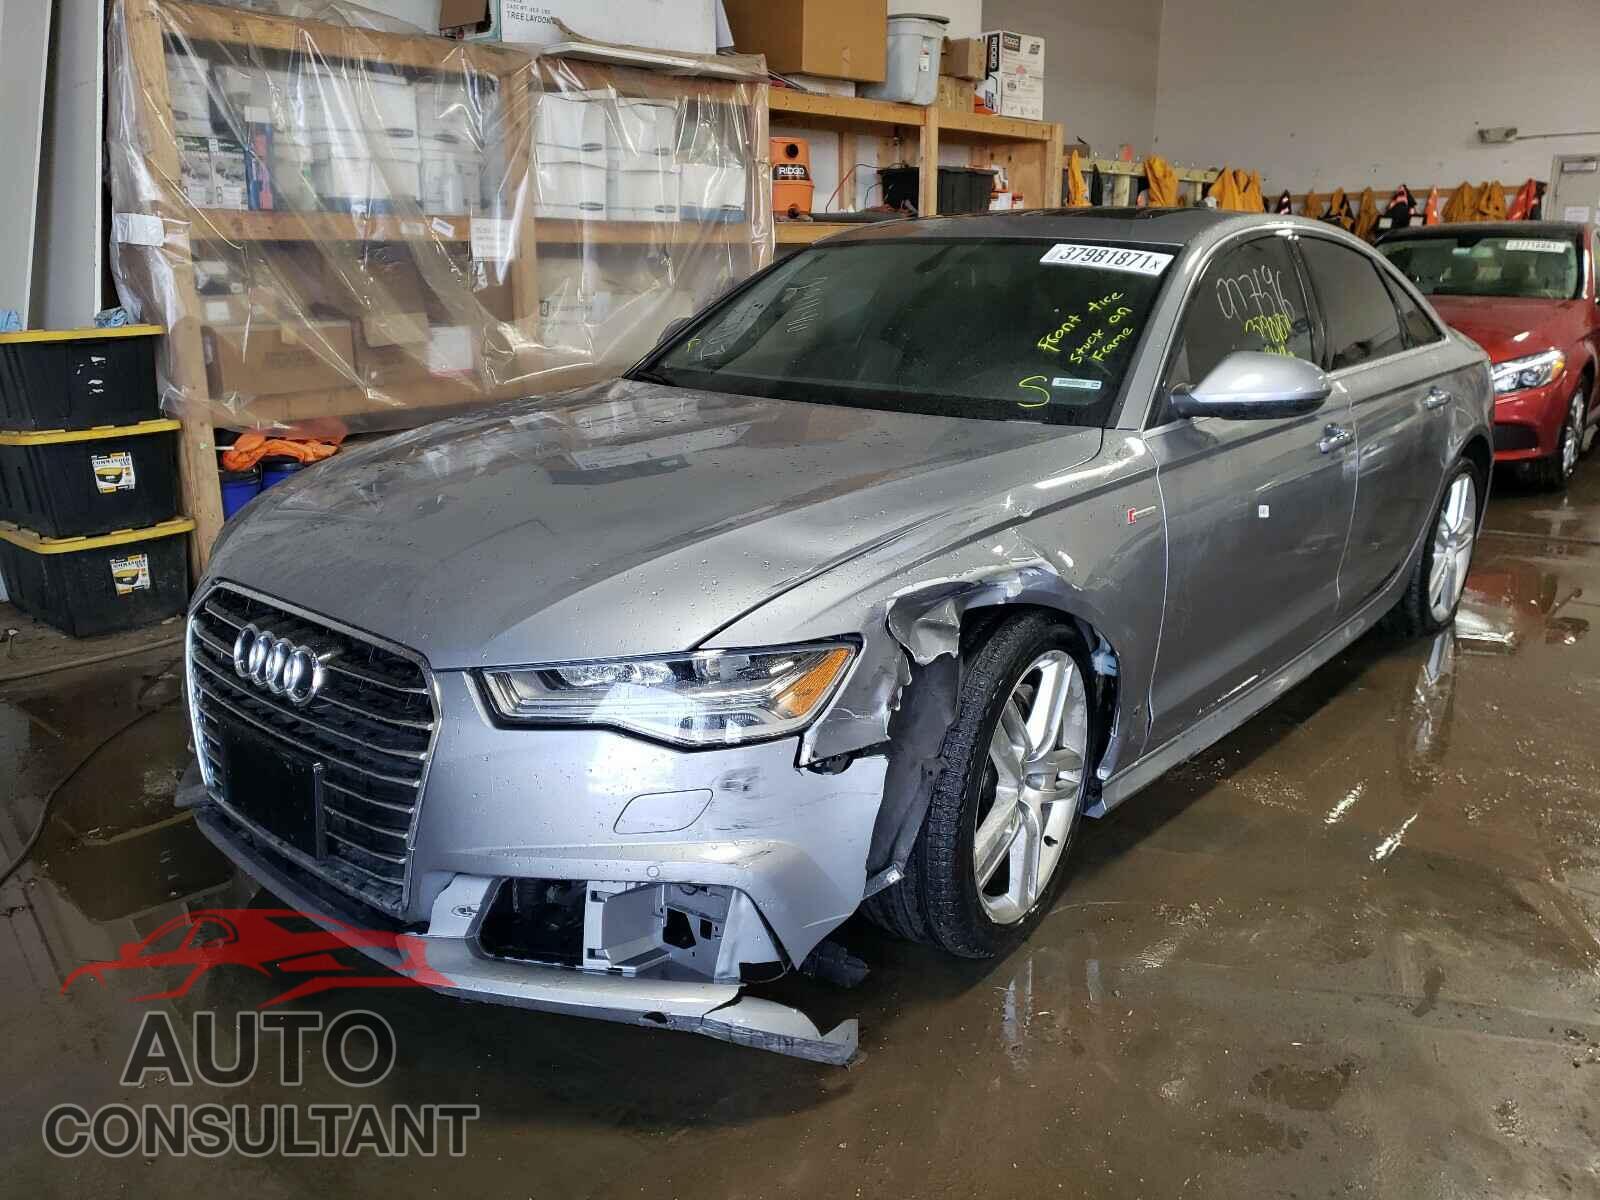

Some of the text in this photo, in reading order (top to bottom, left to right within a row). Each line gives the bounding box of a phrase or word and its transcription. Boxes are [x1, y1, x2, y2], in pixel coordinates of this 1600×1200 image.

[506, 10, 525, 21] TREE
[1060, 246, 1153, 268] 37981871
[1016, 375, 1050, 408] S
